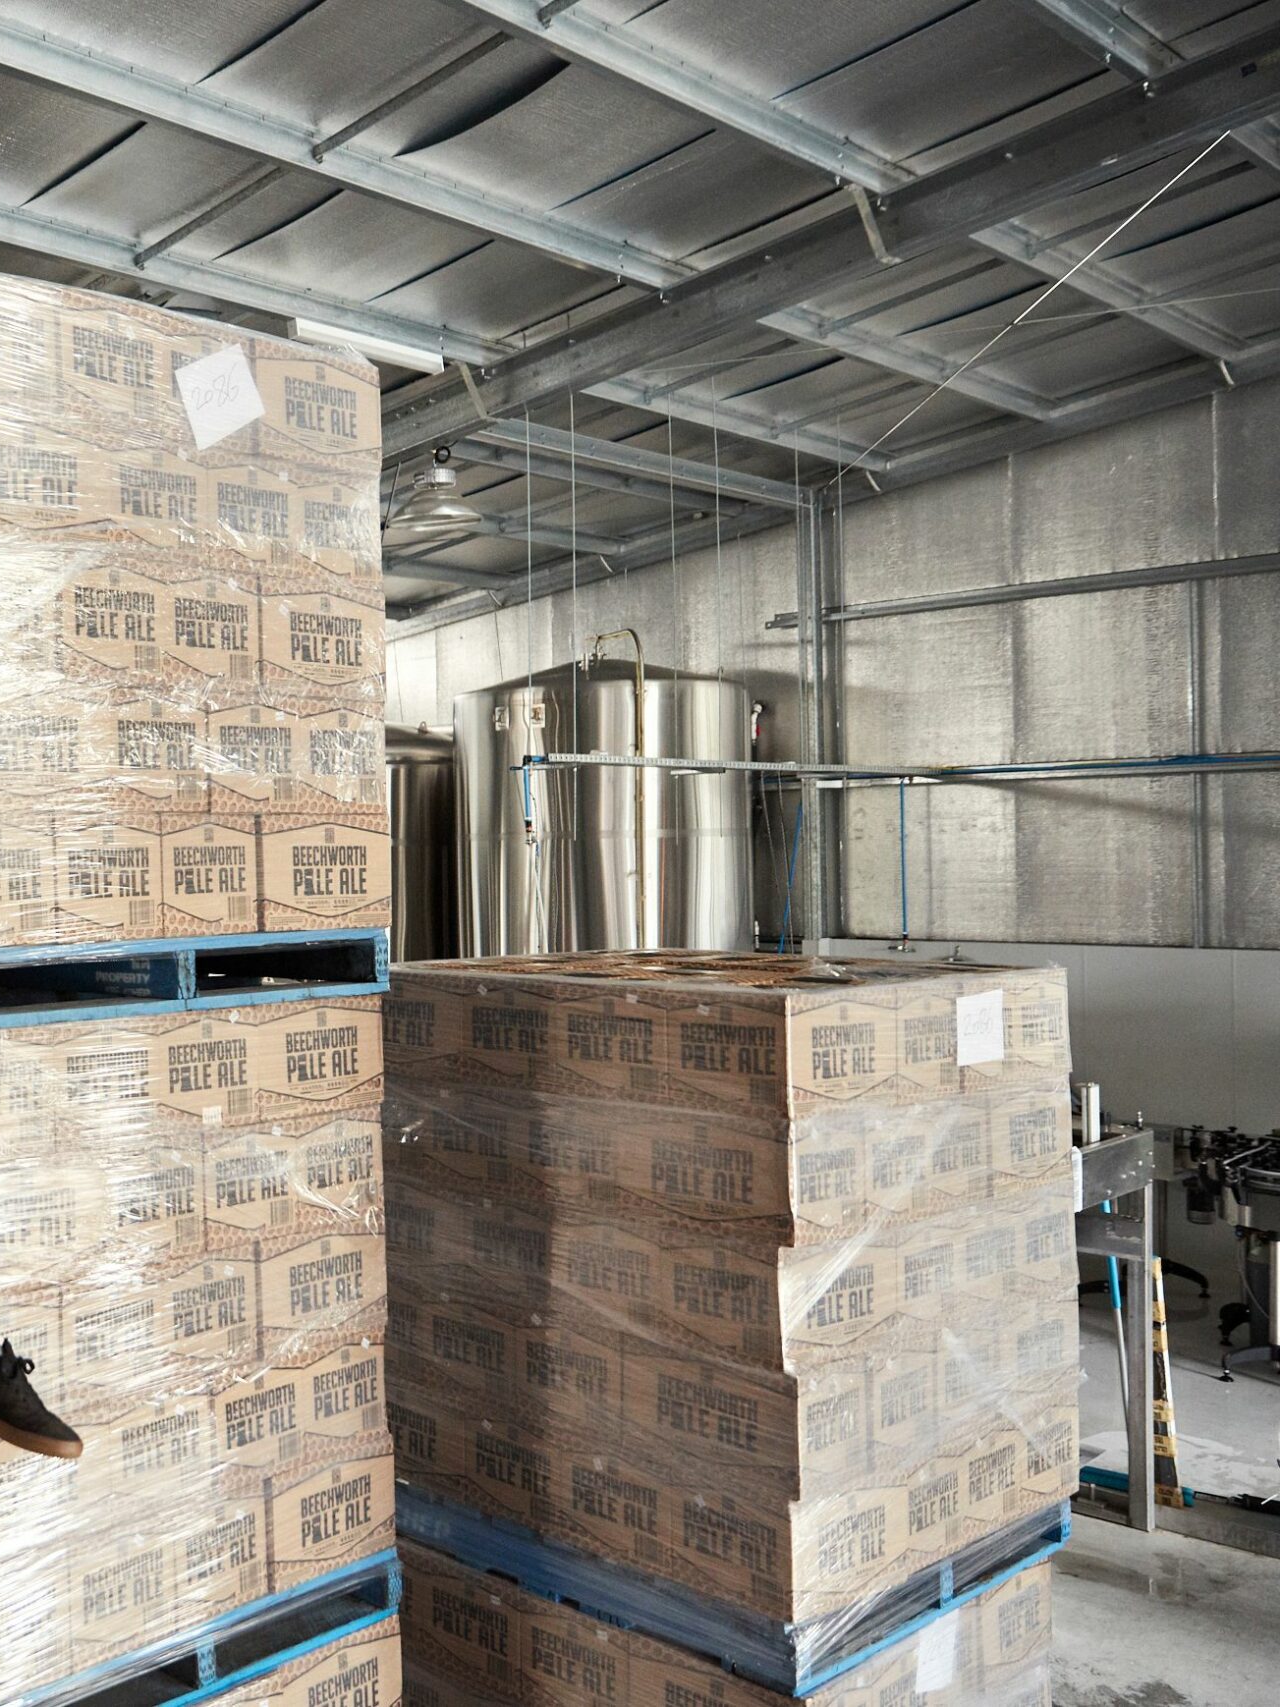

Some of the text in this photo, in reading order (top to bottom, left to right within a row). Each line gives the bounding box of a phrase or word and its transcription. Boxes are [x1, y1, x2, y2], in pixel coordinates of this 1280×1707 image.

[285, 376, 356, 411] BEECHWORTH
[285, 397, 356, 439] PALE ALE
[120, 464, 196, 496] BEECHWORTH
[120, 487, 196, 523] PALE ALE
[218, 482, 288, 513] BEECHWORTH
[263, 510, 288, 538] ALE
[75, 586, 154, 615] BEECHWORTH
[175, 598, 247, 625] BEECHWORTH
[75, 609, 155, 642] PALE ALE
[175, 619, 247, 650] PALE ALE
[290, 612, 361, 638] BEECHWORTH
[290, 635, 362, 665] PALE ALE
[174, 846, 245, 867] BEECHWORTH
[293, 846, 366, 867] BEECHWORTH
[119, 869, 149, 896] ALE
[174, 868, 245, 894] PALE ALE
[293, 868, 366, 896] PALE ALE
[96, 970, 150, 985] PROPERTY
[286, 1026, 357, 1054] BEECHWORTH
[621, 1038, 652, 1064] ALE
[681, 1022, 775, 1047] BEECHWORTH
[812, 1022, 874, 1049] BEECHWORTH
[169, 1039, 246, 1066] BEECHWORTH
[286, 1048, 358, 1082] PALE ALE
[681, 1044, 775, 1075] PALE ALE
[812, 1045, 875, 1079] PALE ALE
[169, 1060, 246, 1093] PALE ALE
[307, 1156, 373, 1190] PALE ALE
[715, 1171, 752, 1203] ALE
[167, 1189, 194, 1219] ALE
[216, 1172, 288, 1208] PALE ALE
[290, 1251, 362, 1287] BEECHWORTH
[173, 1276, 244, 1310] BEECHWORTH
[290, 1273, 363, 1316] PALE ALE
[849, 1287, 873, 1320] ALE
[174, 1304, 213, 1339] PALE
[219, 1298, 245, 1329] ALE
[314, 1359, 376, 1395] BEECHWORTH
[226, 1383, 295, 1422] BEECHWORTH
[314, 1378, 377, 1420] PALE ALE
[226, 1404, 296, 1449] PALE ALE
[302, 1474, 370, 1517] BEECHWORTH
[302, 1506, 341, 1548] PALE
[347, 1496, 370, 1530] ALE
[626, 1501, 658, 1535] ALE
[909, 1494, 958, 1535] PALE ALE
[230, 1533, 256, 1567] ALE
[861, 1529, 884, 1563] ALE
[480, 1623, 508, 1656] ALE
[308, 1657, 378, 1707] BEECHWORTH
[353, 1680, 379, 1707] ALE
